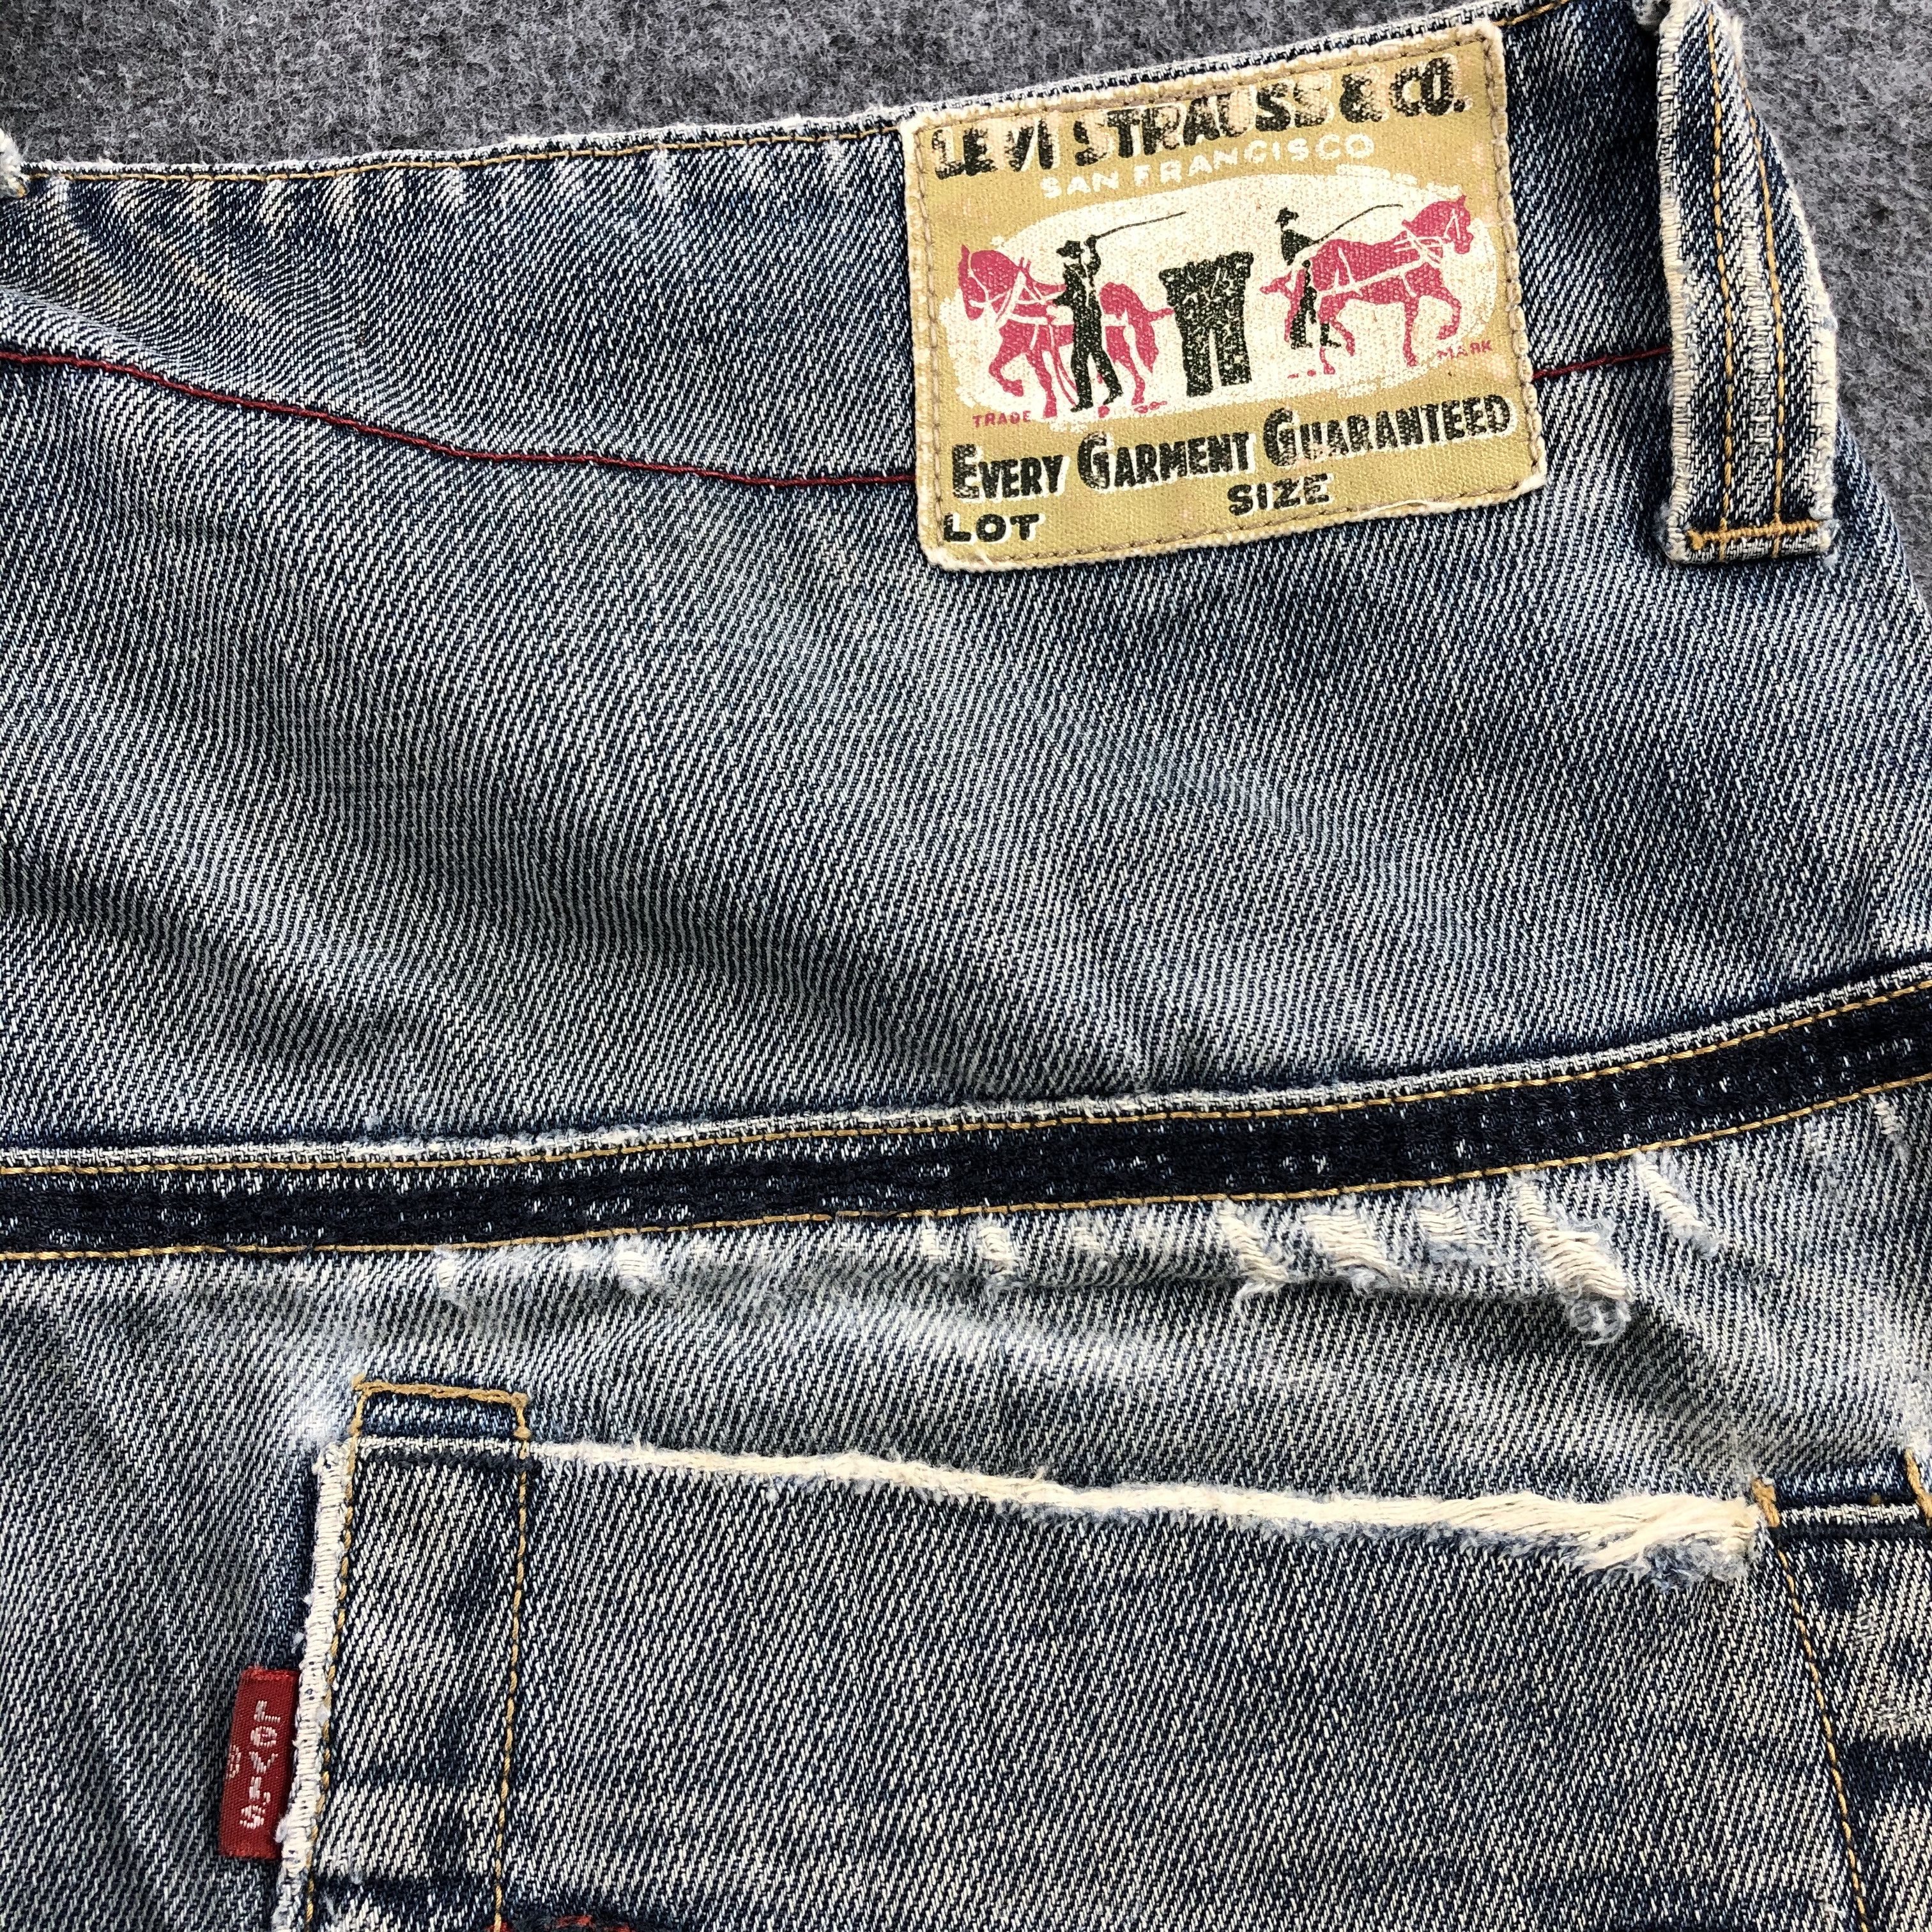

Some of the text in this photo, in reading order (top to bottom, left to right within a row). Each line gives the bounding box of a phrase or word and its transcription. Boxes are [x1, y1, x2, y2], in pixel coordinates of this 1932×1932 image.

[931, 55, 1472, 180] LEVI STRAUSS & CO.
[1040, 133, 1374, 199] SAN FRANCISCO
[1437, 340, 1492, 360] MARK
[972, 410, 1032, 428] TRADE
[952, 394, 1513, 501] EVERY GARMENT GUARANTEED
[1227, 473, 1333, 516] SIZE
[943, 512, 1043, 543] LOT
